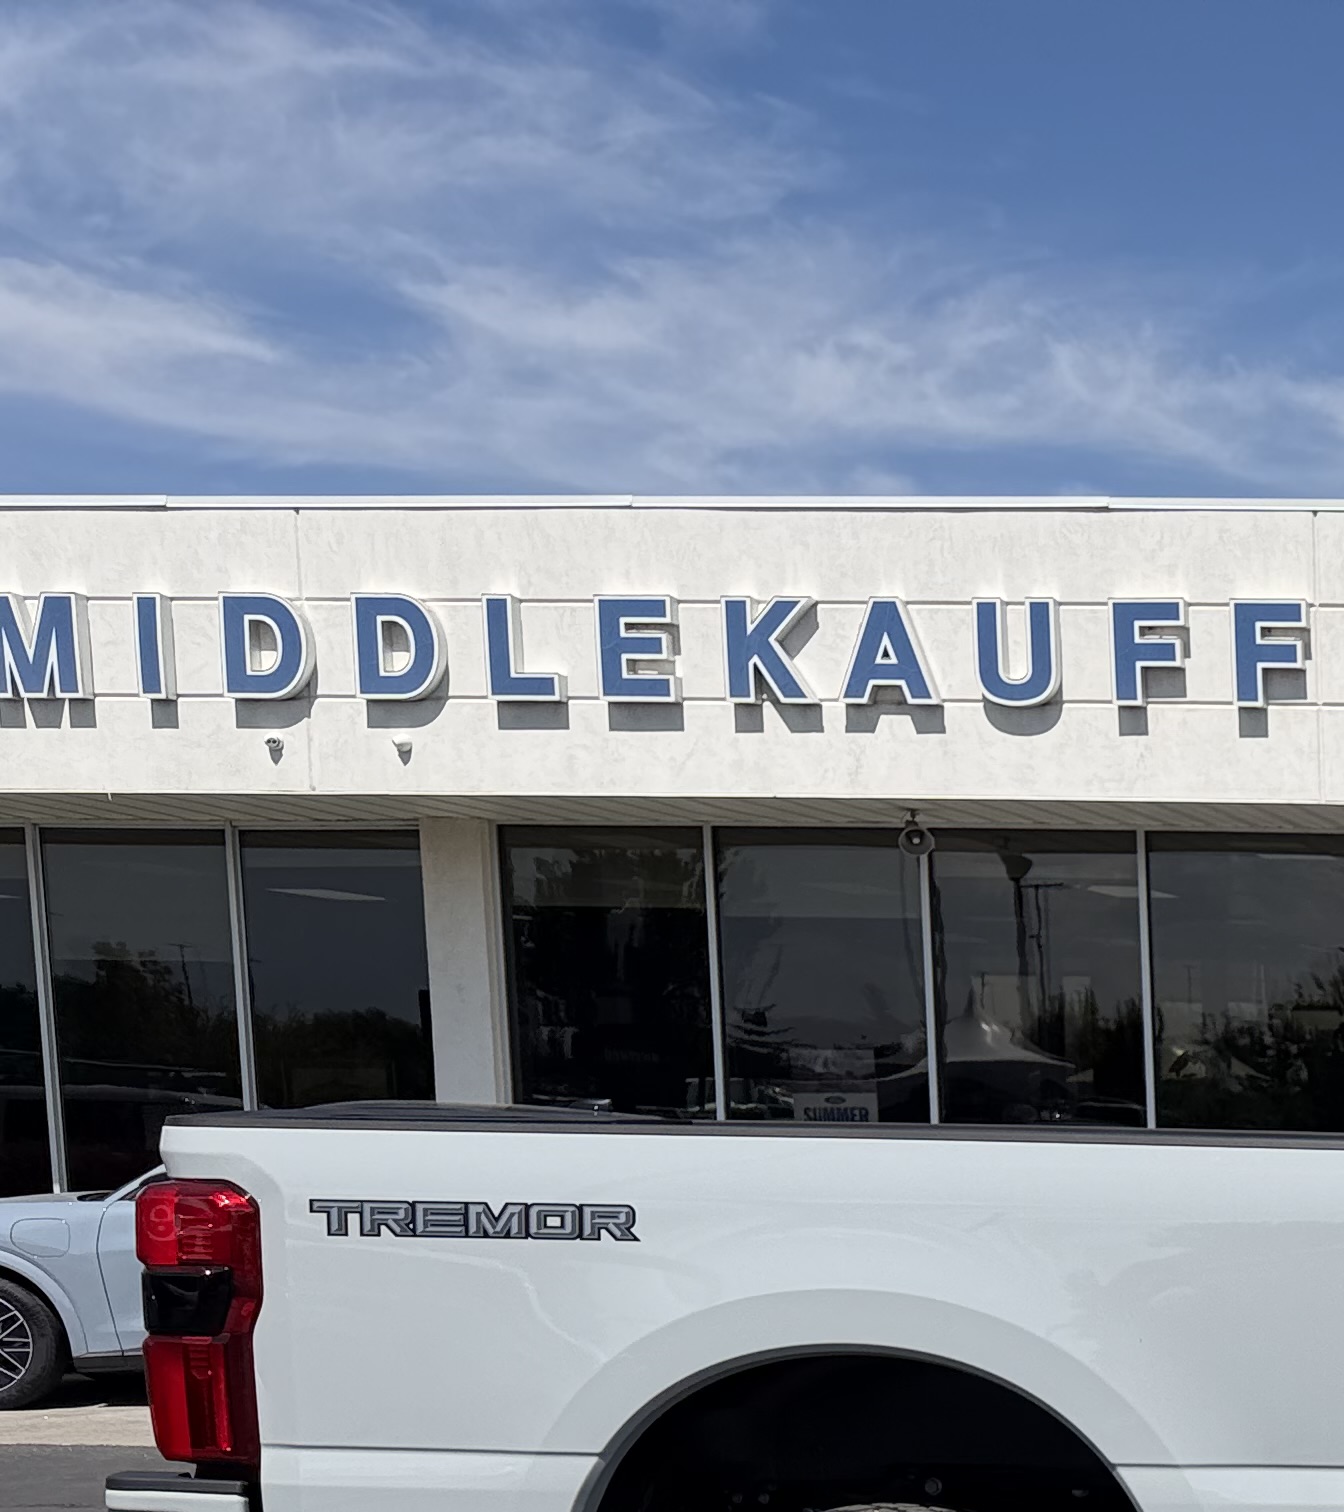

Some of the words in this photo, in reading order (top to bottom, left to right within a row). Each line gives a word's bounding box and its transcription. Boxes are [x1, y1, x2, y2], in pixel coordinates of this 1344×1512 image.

[0, 591, 1308, 707] MIDDLEKAUFF
[804, 1106, 869, 1121] SUMMER
[309, 1199, 640, 1242] TREMOR
